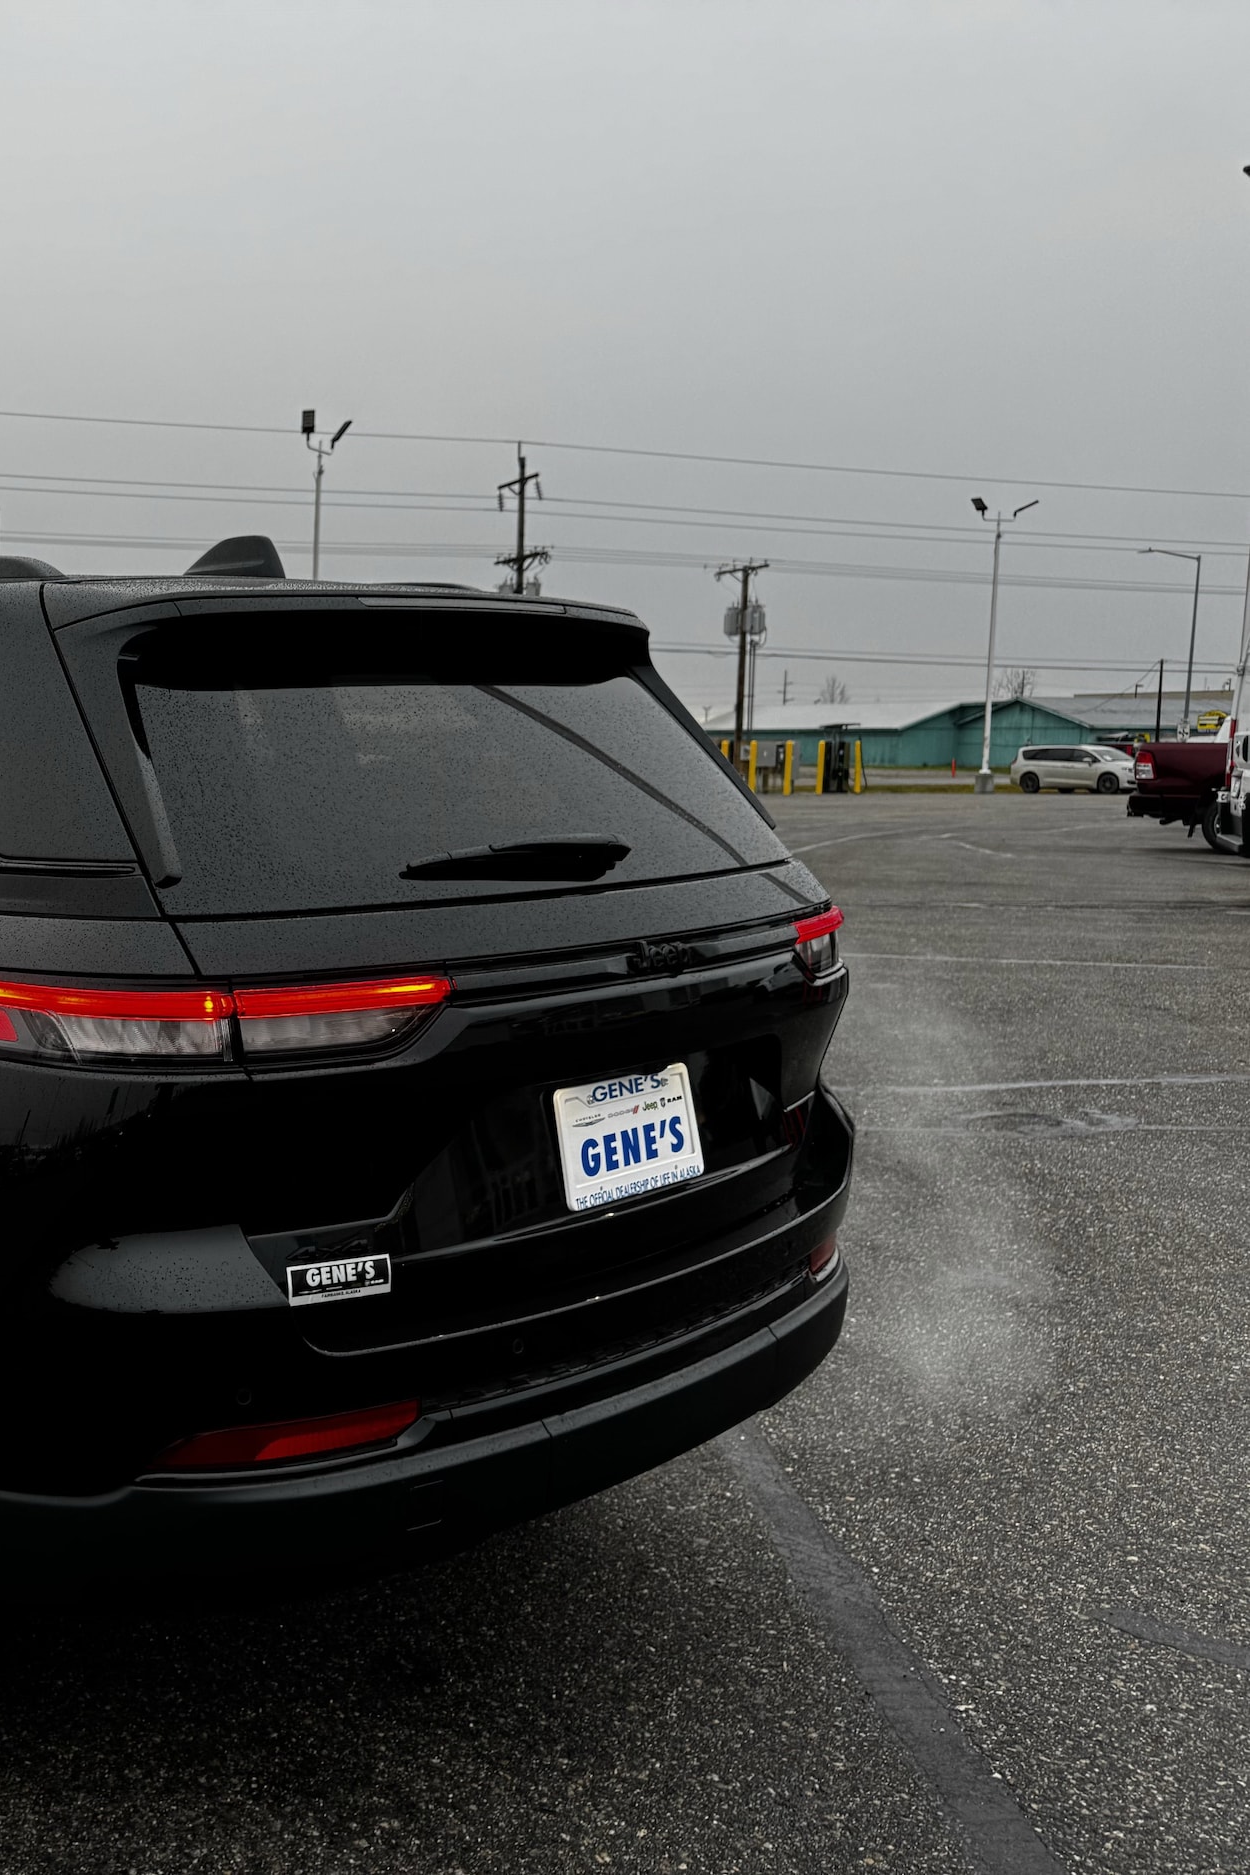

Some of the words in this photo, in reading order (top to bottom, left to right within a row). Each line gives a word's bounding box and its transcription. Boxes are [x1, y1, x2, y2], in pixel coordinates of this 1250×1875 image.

[592, 1073, 661, 1102] GENE'S
[642, 1100, 658, 1112] Jeep
[667, 1095, 682, 1103] RAM
[581, 1116, 685, 1177] GENE'S
[575, 1196, 588, 1209] THE
[589, 1189, 615, 1207] OFFICIAL
[616, 1179, 650, 1198] DEALERSHIP
[650, 1175, 659, 1189] OF
[659, 1172, 671, 1186] LIFE
[671, 1169, 679, 1183] IN
[679, 1165, 701, 1179] ALASKA
[306, 1260, 375, 1287] GENE'S
